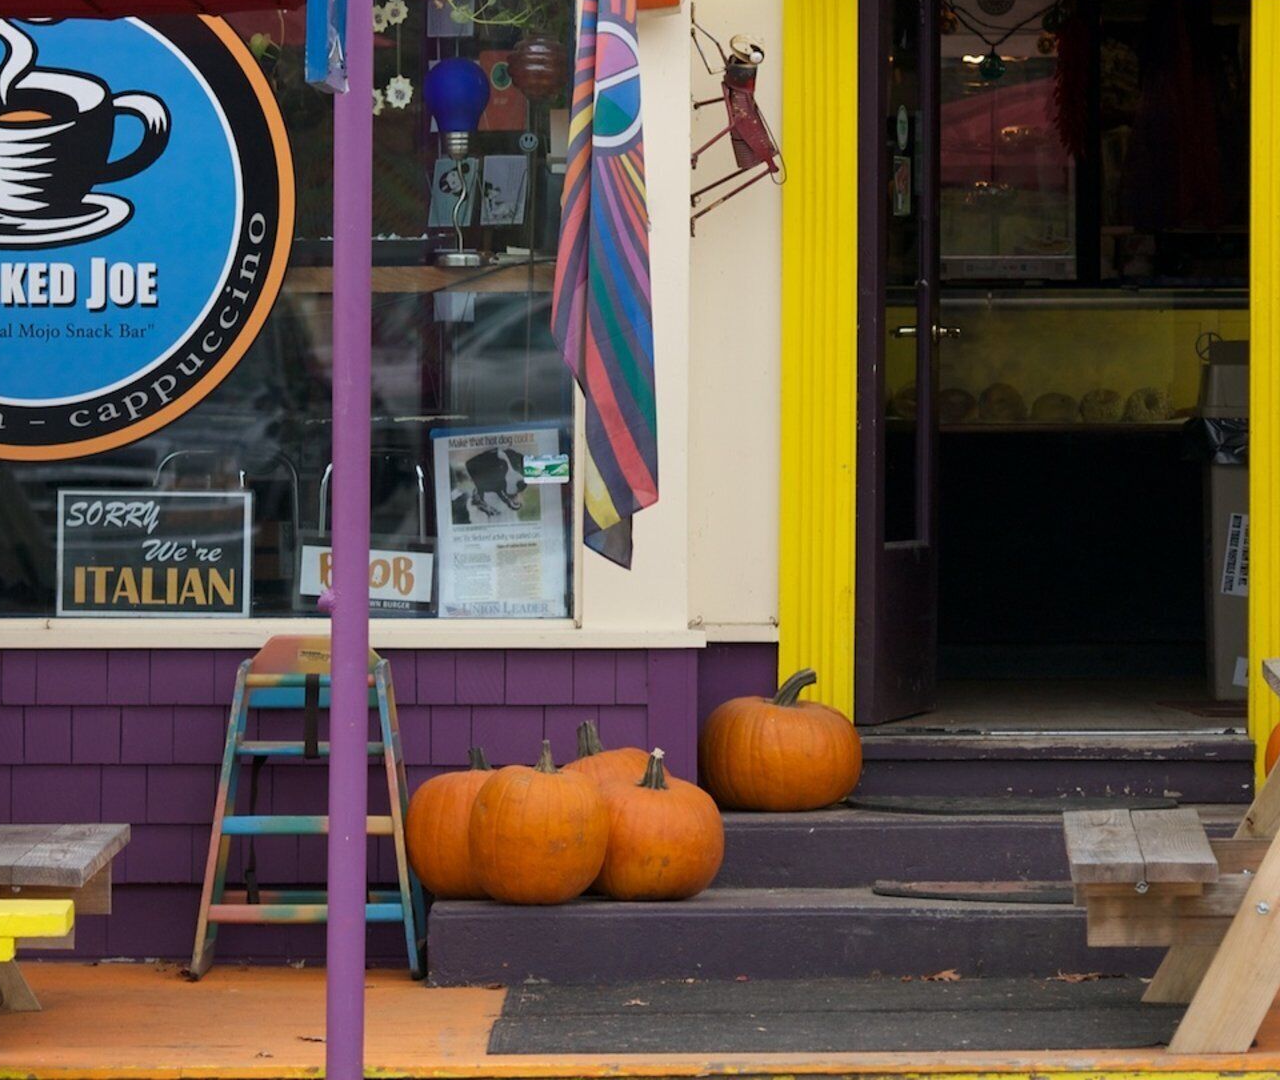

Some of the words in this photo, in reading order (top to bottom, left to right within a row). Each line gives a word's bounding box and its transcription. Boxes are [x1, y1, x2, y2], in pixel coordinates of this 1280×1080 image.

[85, 256, 159, 311] JOE
[18, 324, 61, 344] Mojo
[66, 324, 113, 339] Snack
[69, 212, 267, 428] cappuccino
[66, 500, 161, 535] SORRY
[142, 538, 222, 562] We're
[74, 566, 235, 606] ITALIAN
[320, 551, 415, 596] BOB
[463, 601, 501, 616] UNION
[504, 600, 549, 614] LEADER
